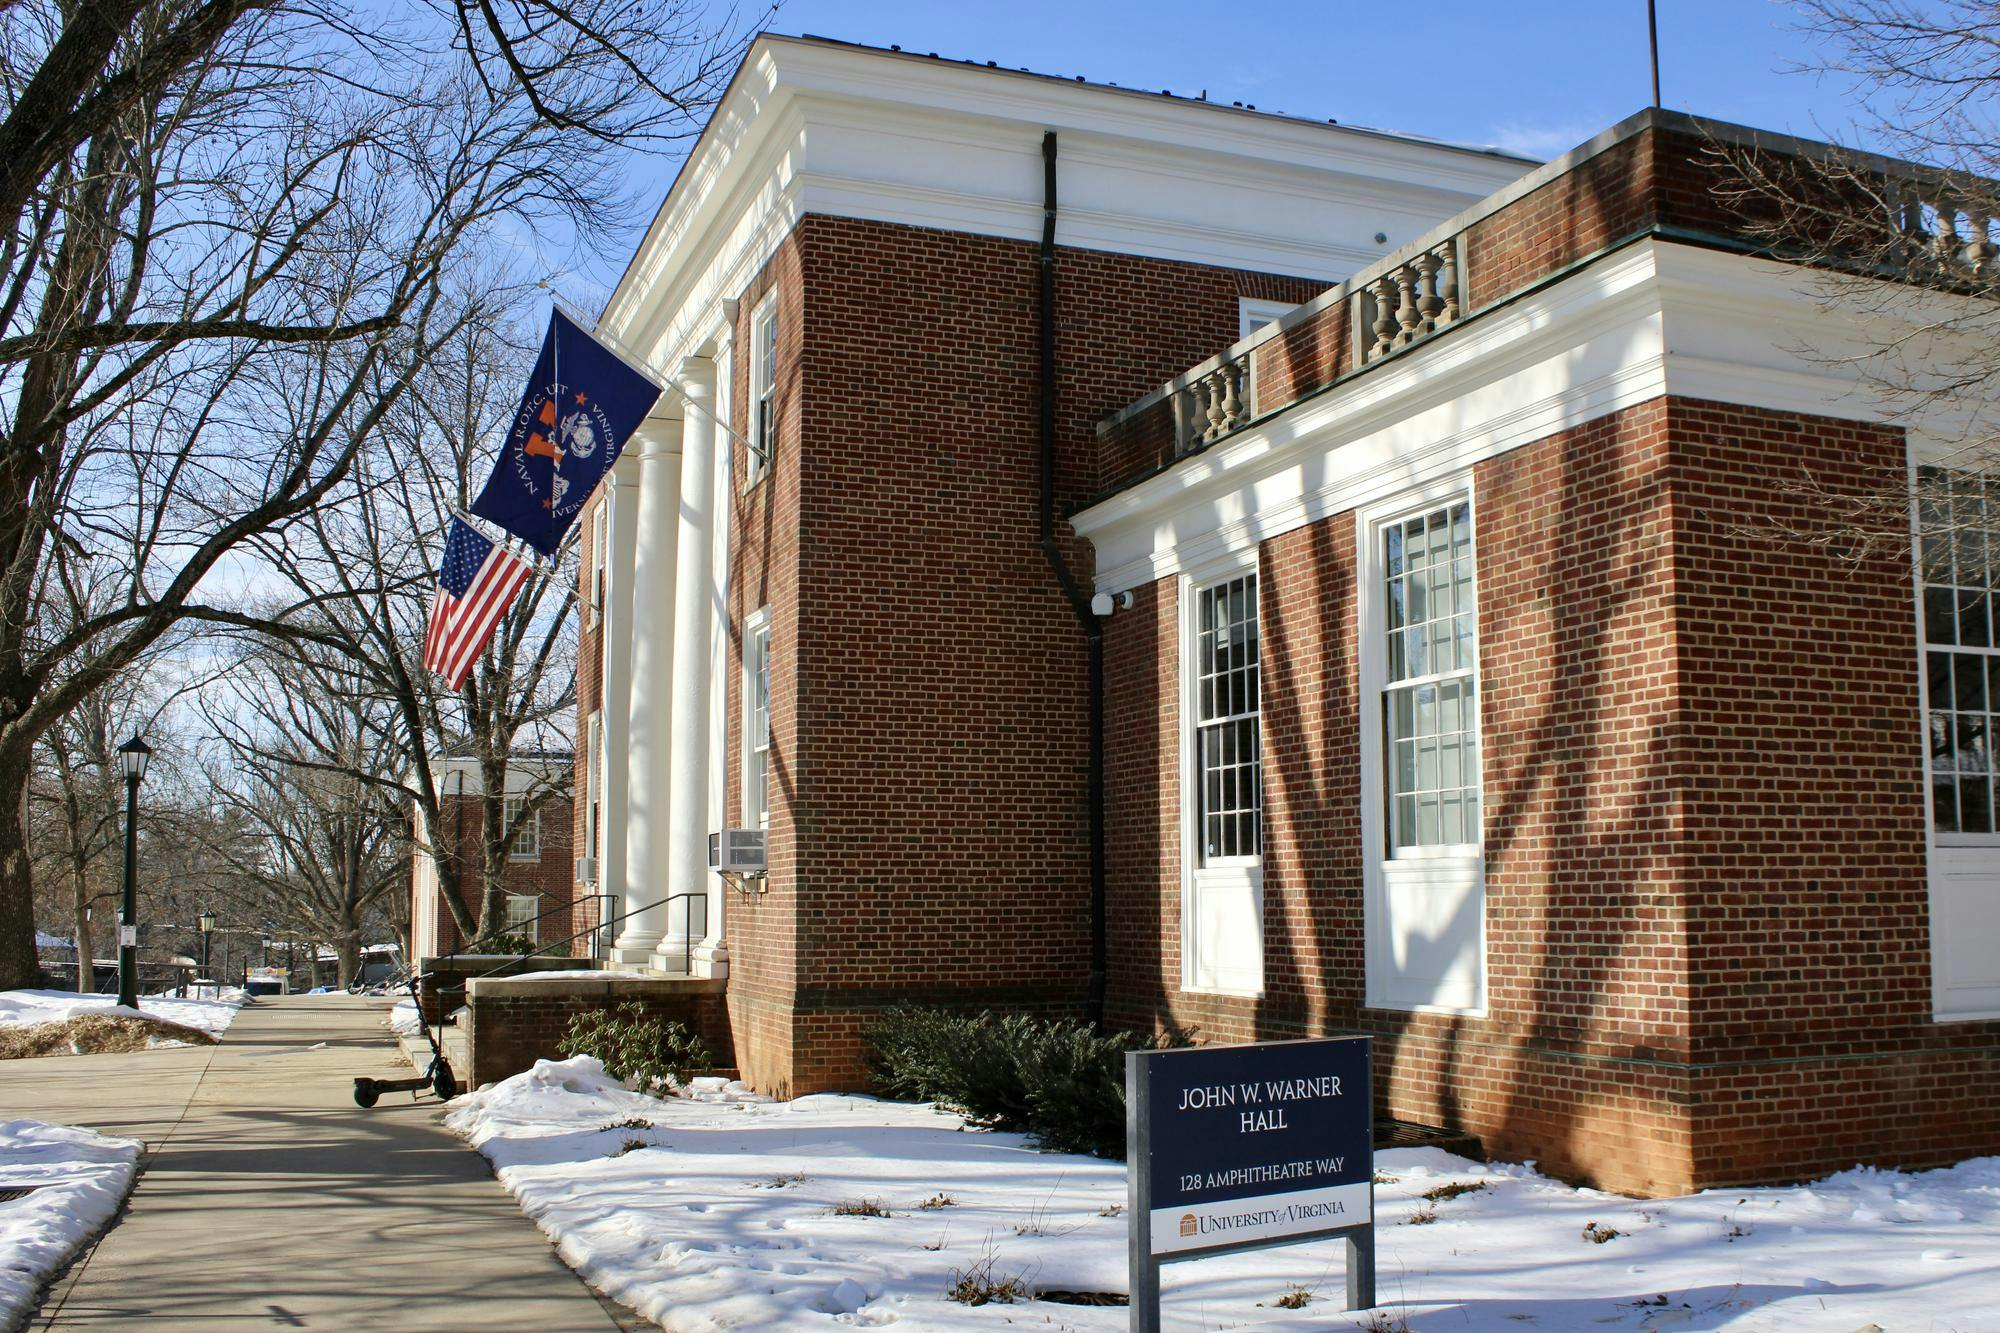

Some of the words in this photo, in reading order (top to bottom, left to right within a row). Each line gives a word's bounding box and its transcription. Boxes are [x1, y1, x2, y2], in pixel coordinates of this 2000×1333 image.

[515, 394, 546, 438] R.O.T.C.
[593, 404, 614, 464] VIRGINIA
[514, 443, 538, 495] NAVAL
[1179, 1085, 1235, 1110] JOHN
[1240, 1083, 1262, 1104] W.
[1265, 1076, 1342, 1101] WARNER
[1240, 1109, 1287, 1133] HALL
[1180, 1174, 1202, 1191] 128
[1206, 1161, 1312, 1188] AMPHITHEATRE
[1316, 1157, 1344, 1174] WAY
[1200, 1210, 1279, 1234] UNIVERSITY
[1279, 1208, 1288, 1225] of
[1288, 1201, 1345, 1222] VIRGINIA
